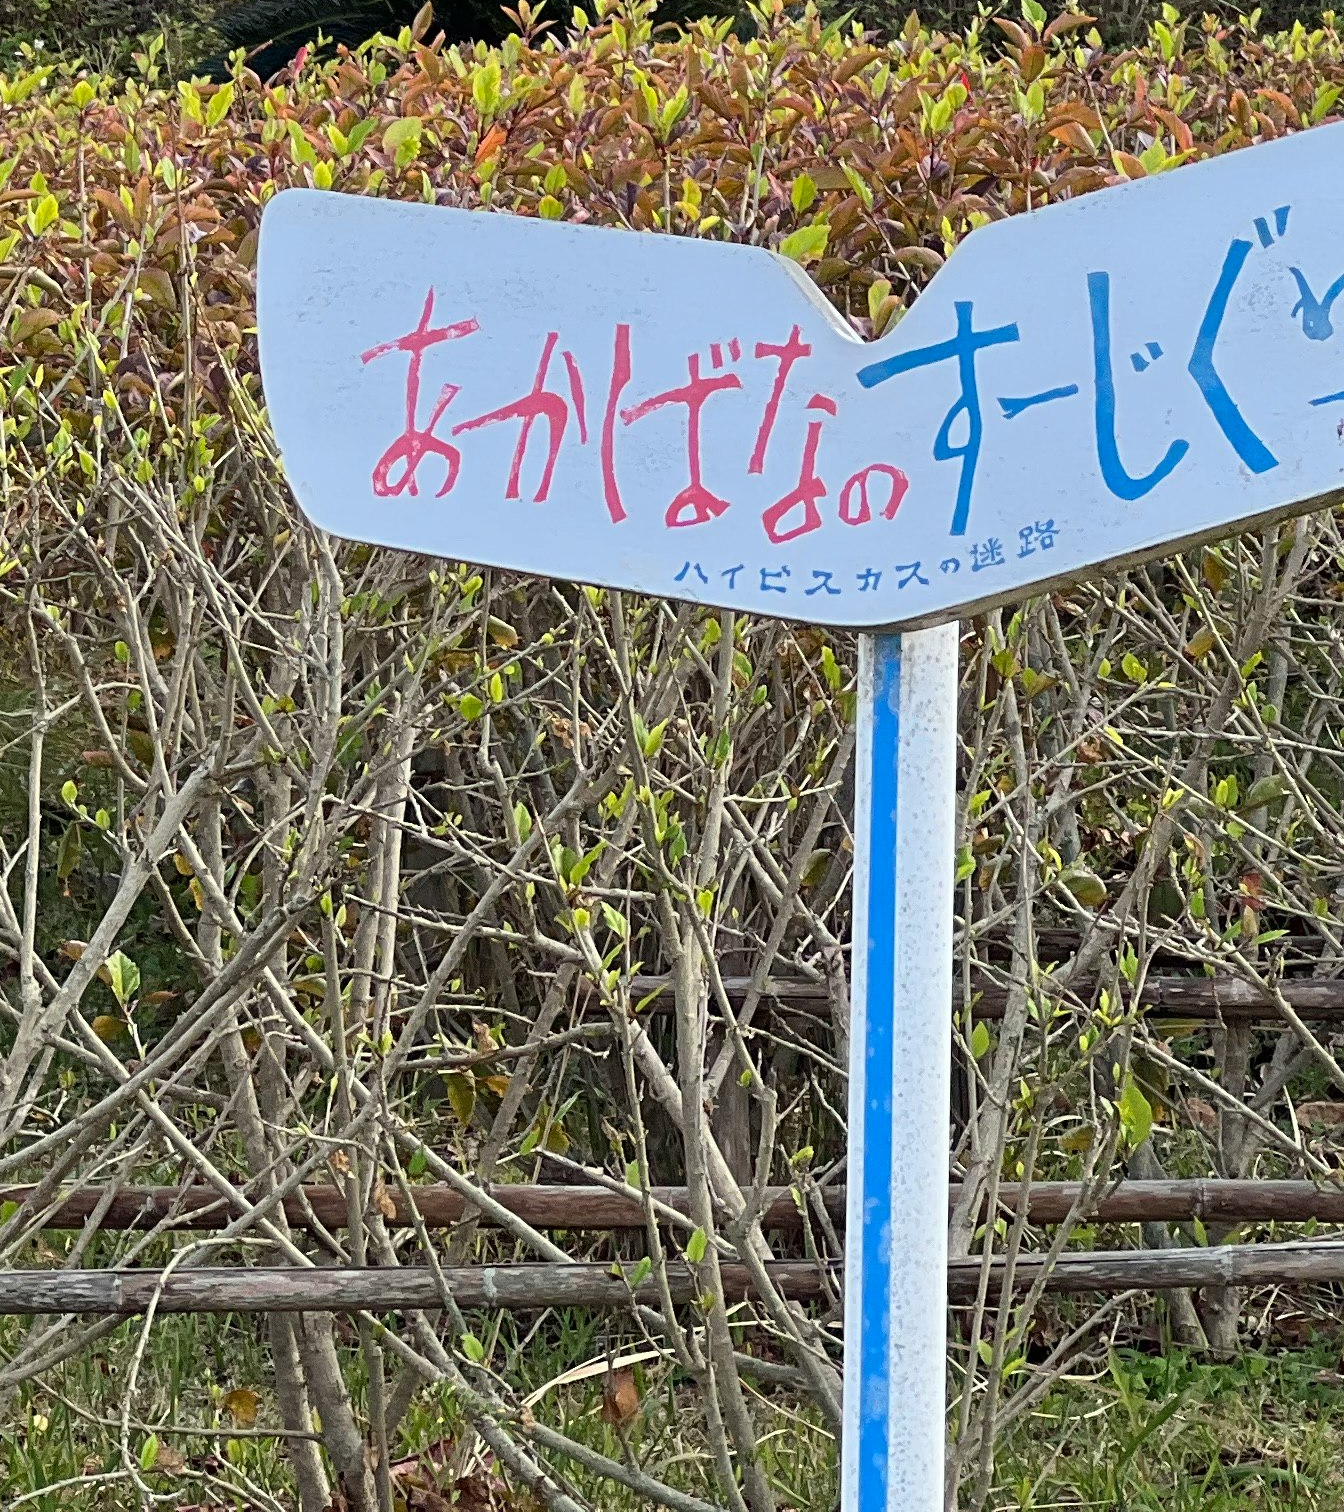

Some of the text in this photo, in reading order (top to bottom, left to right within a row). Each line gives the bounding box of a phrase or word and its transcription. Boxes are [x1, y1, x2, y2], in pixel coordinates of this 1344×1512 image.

[673, 518, 1060, 596] ハイビスカスの迷路
